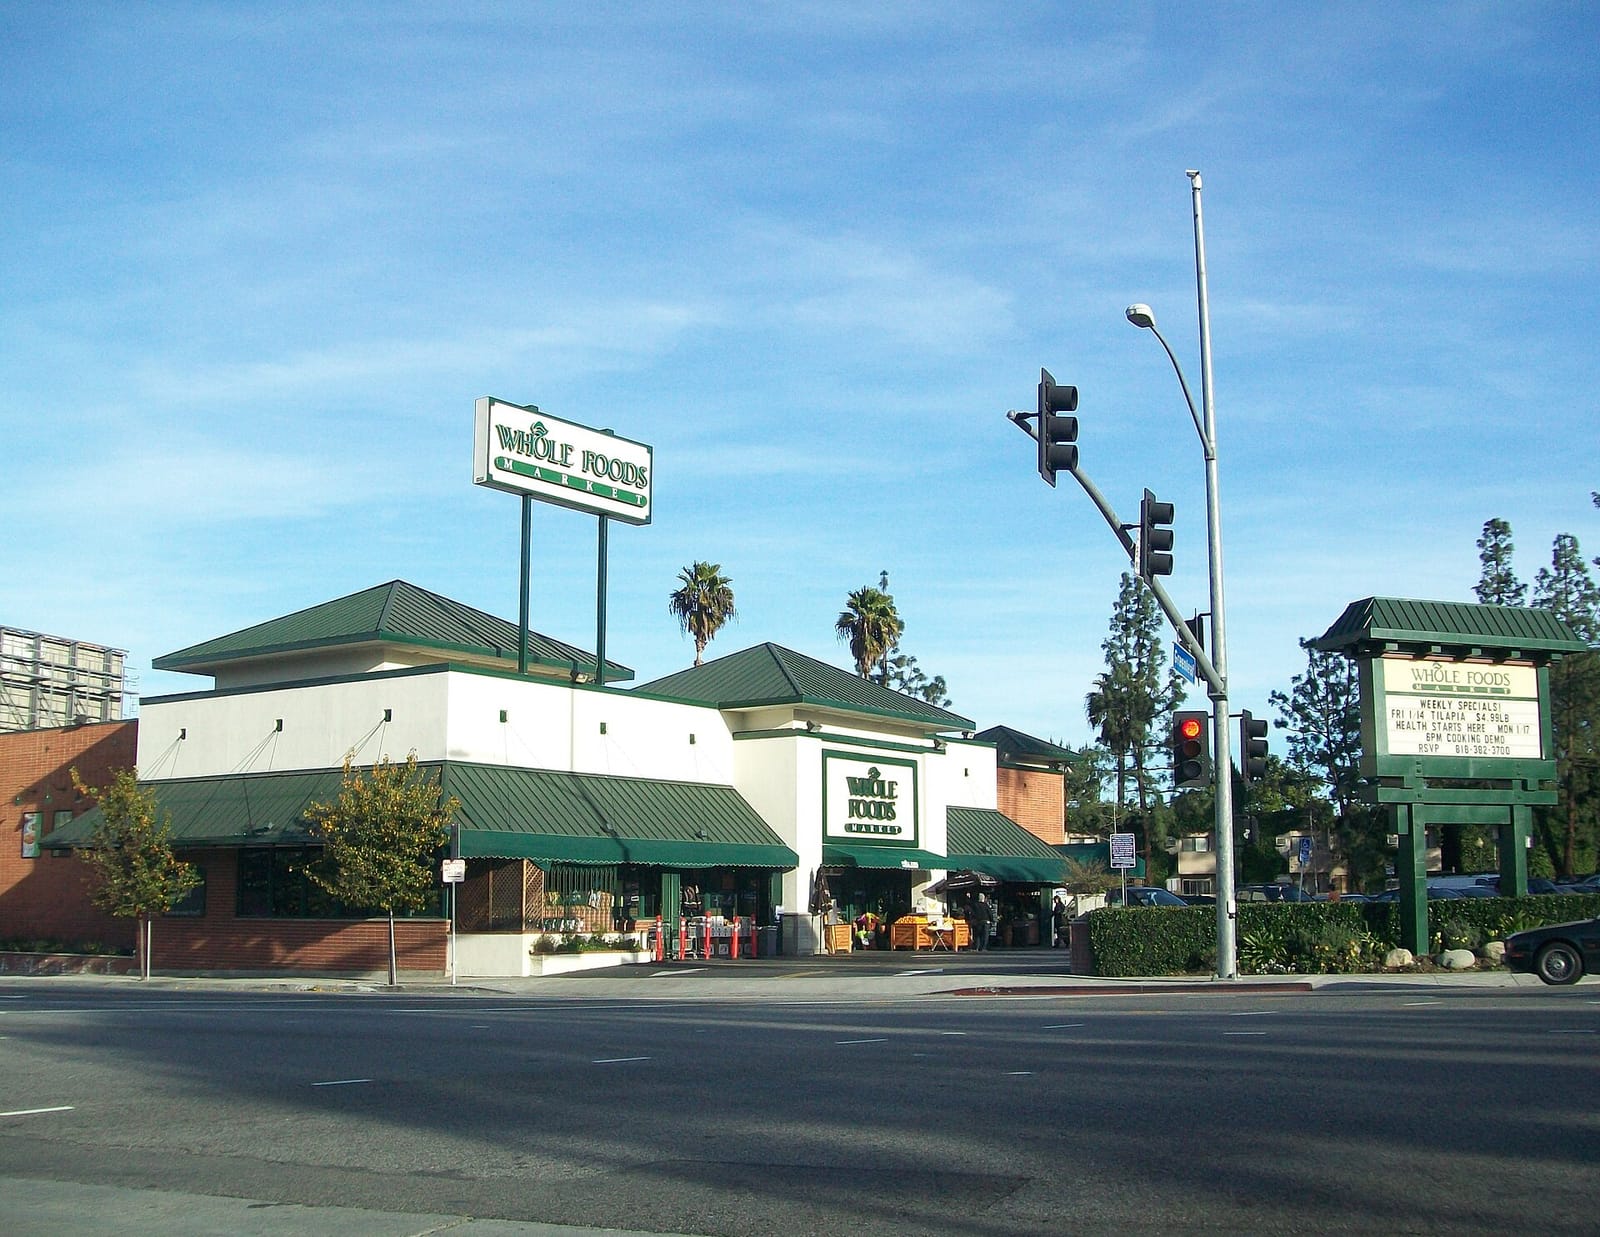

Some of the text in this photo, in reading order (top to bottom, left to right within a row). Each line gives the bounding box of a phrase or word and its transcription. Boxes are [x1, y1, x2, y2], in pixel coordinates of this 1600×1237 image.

[496, 424, 648, 489] WHOLE FOODS
[503, 458, 643, 505] MARKET
[1411, 668, 1511, 686] WHOLE FOODS
[1415, 684, 1508, 695] MARKET
[1420, 699, 1452, 710] WEEKLY
[1391, 709, 1510, 723] FRI 1/14 TILAPIA $4.99LB
[1396, 720, 1427, 731] HEALTH
[1432, 721, 1462, 732] STARTS
[1467, 723, 1486, 733] HERE
[1497, 724, 1513, 734] MON
[1426, 732, 1505, 744] 6PM COOKING DEMO
[1418, 743, 1440, 753] RSVP
[846, 776, 898, 800] WHOLE
[848, 799, 896, 821] FOODS
[851, 824, 900, 834] MARKET
